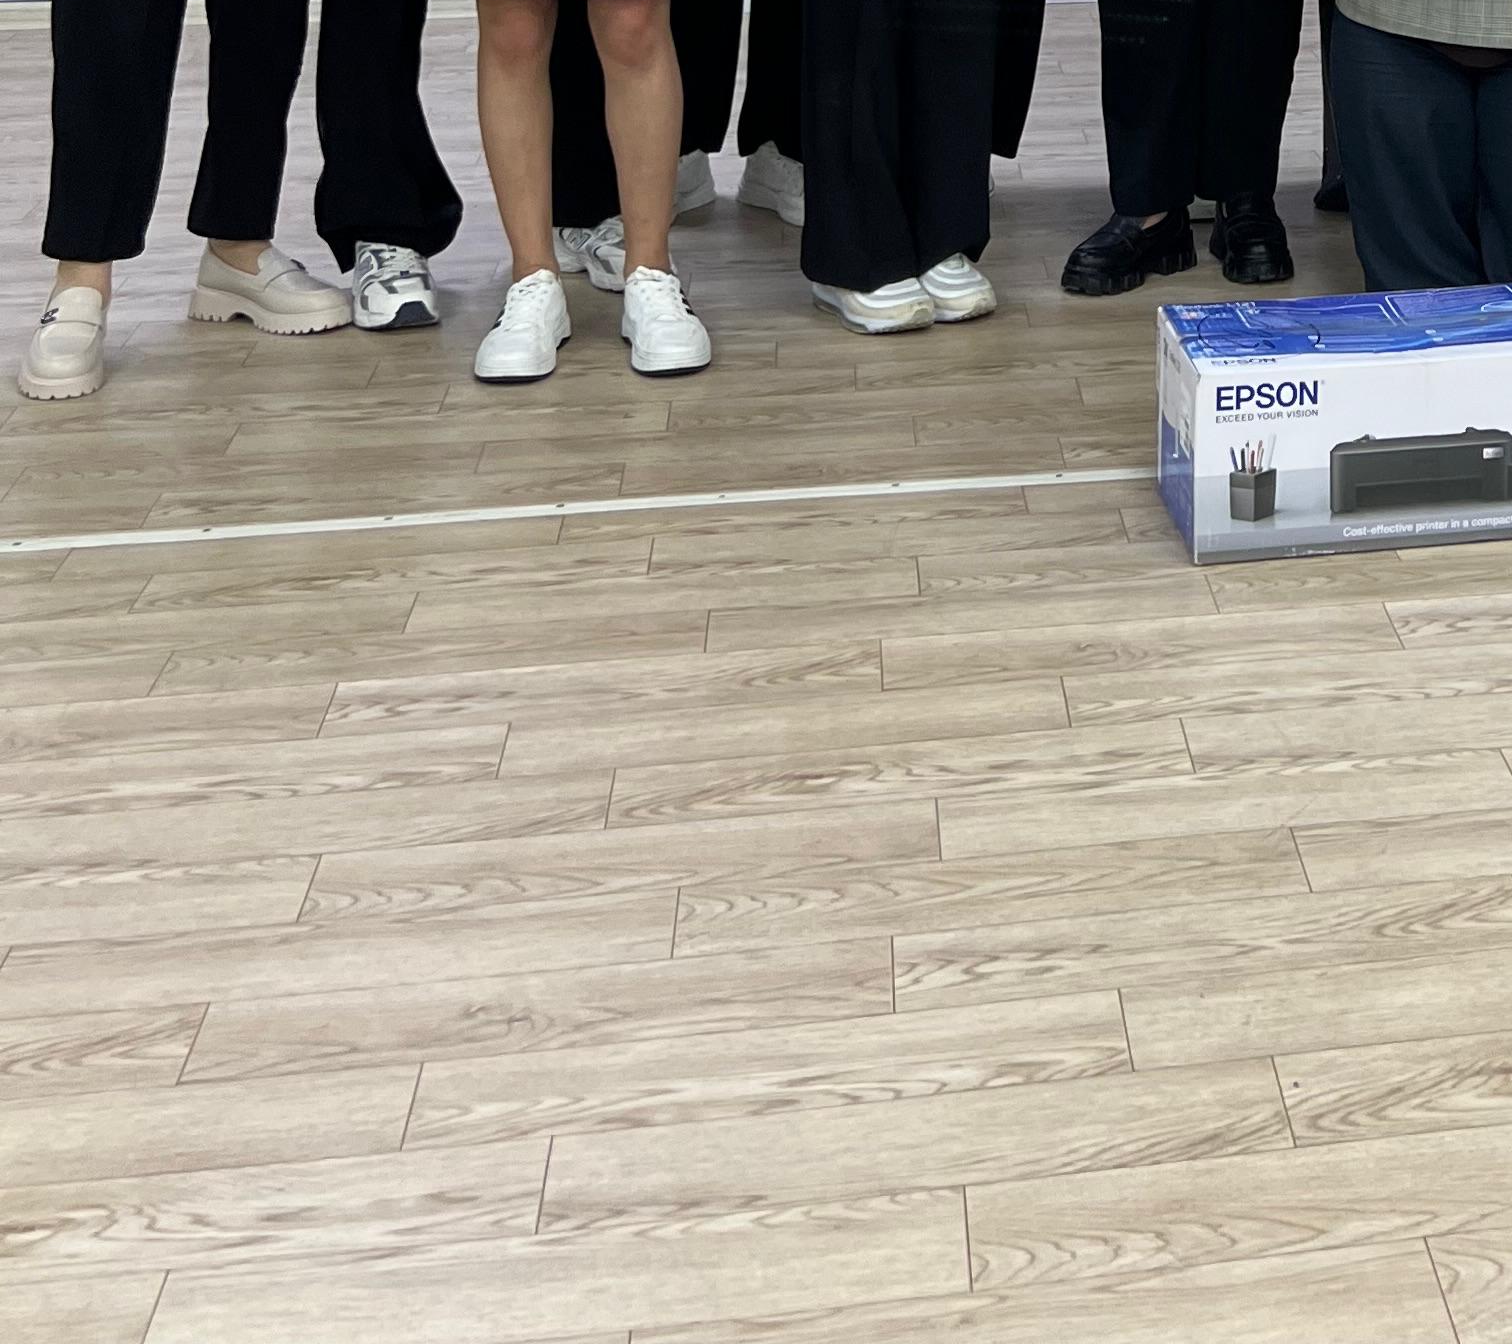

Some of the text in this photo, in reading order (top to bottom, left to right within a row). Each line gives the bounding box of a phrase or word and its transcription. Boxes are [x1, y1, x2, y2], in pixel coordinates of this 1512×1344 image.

[1216, 380, 1319, 412] EPSON
[1215, 409, 1319, 424] EXCEED YOUR VISION
[1343, 524, 1413, 537] Cost-effective
[1415, 520, 1449, 533] printer
[1450, 518, 1460, 528] in
[1462, 519, 1469, 528] a
